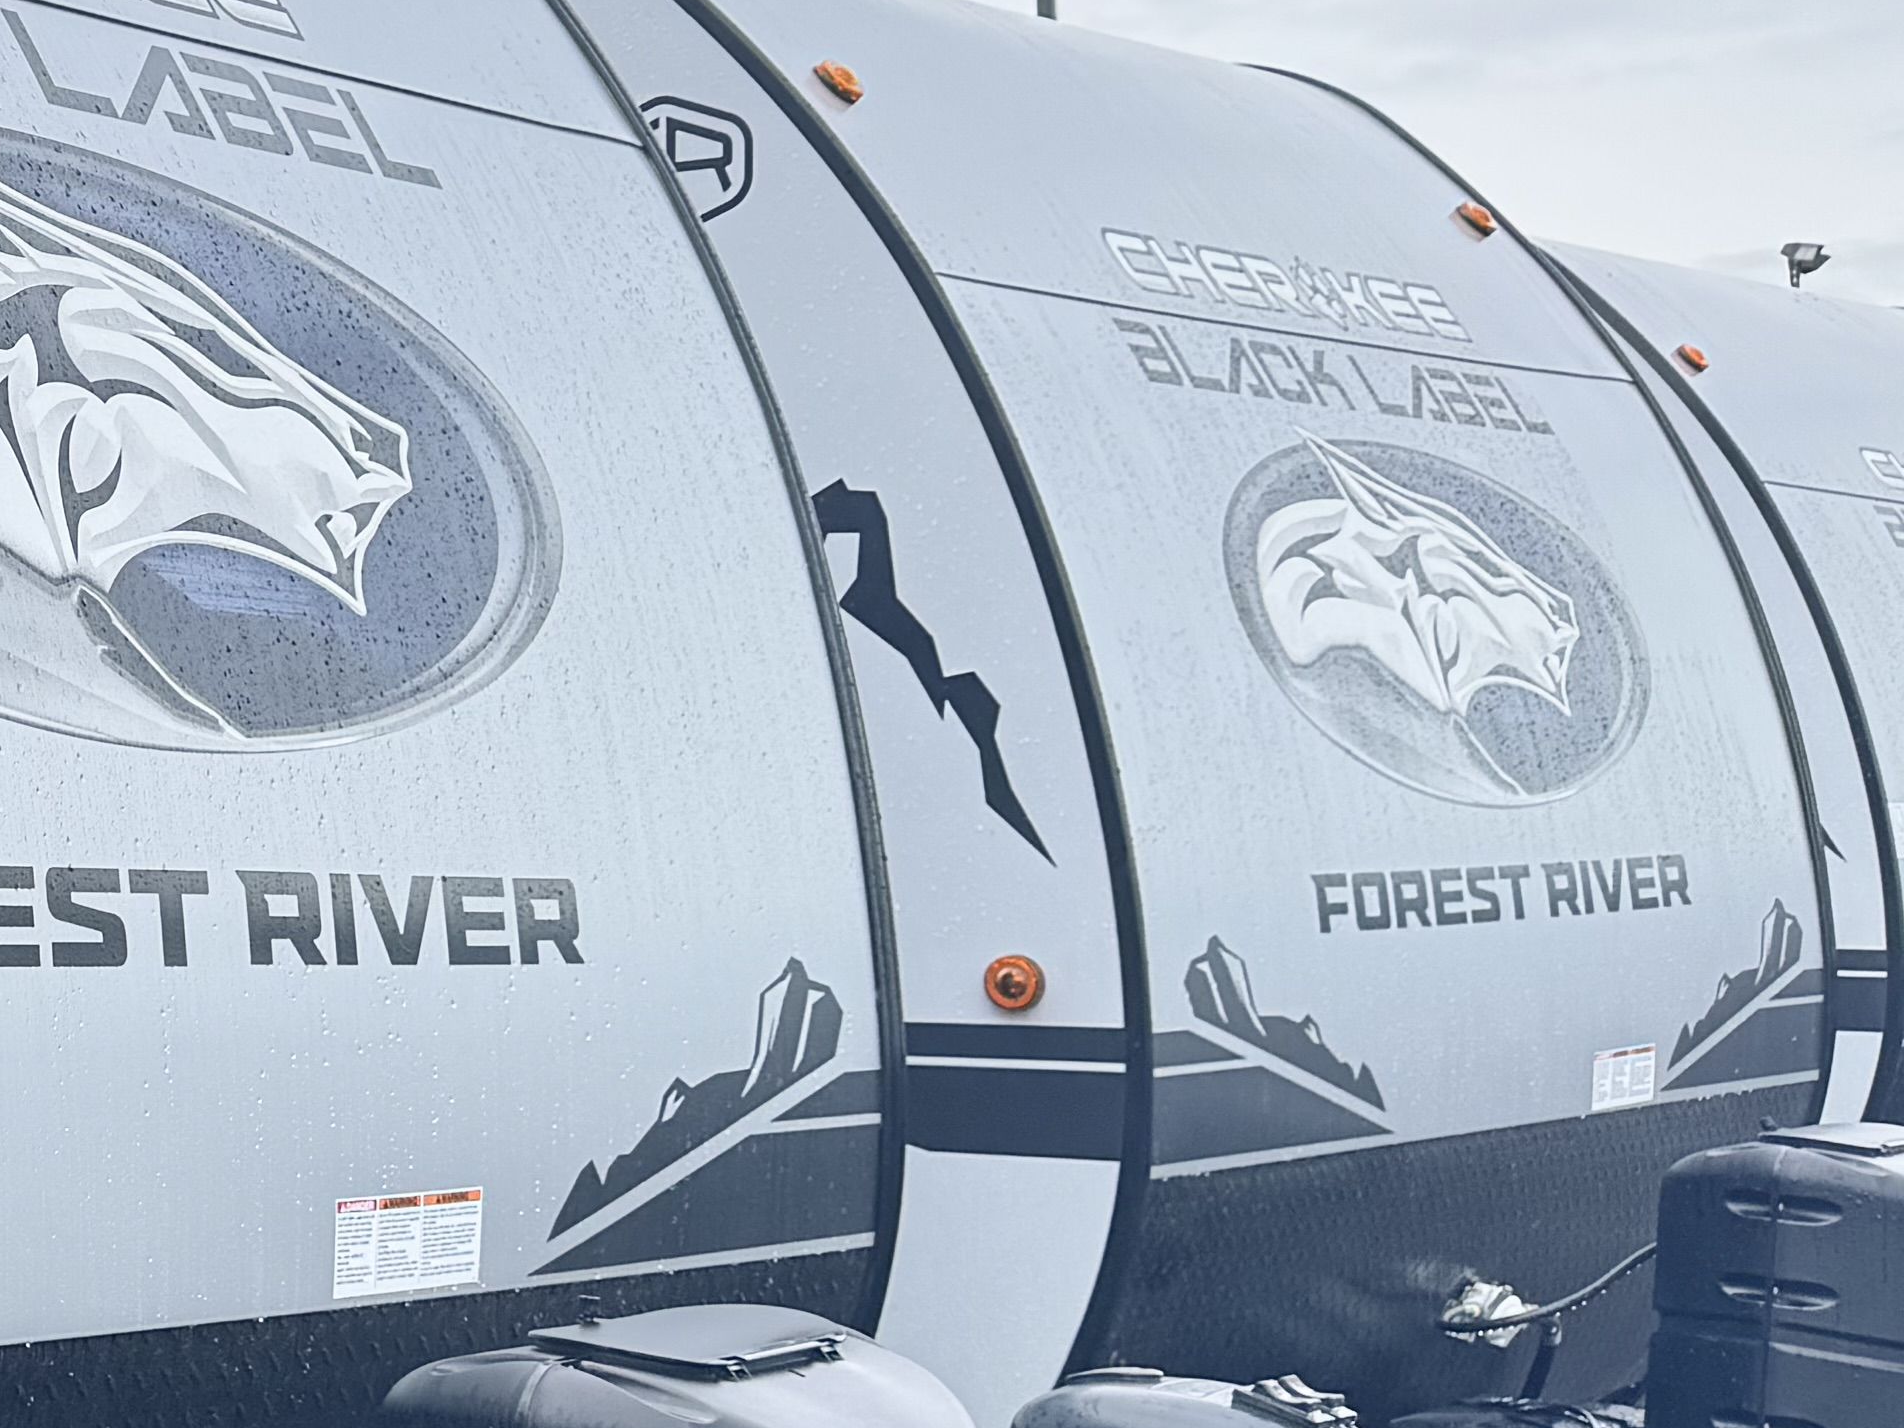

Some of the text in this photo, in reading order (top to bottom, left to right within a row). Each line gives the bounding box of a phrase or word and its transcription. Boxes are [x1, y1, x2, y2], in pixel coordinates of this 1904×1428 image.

[2, 9, 443, 189] LABEL
[1112, 317, 1555, 435] BLACK LABEL
[236, 869, 586, 966] RIVER
[1310, 854, 1692, 933] FOREST RIVER
